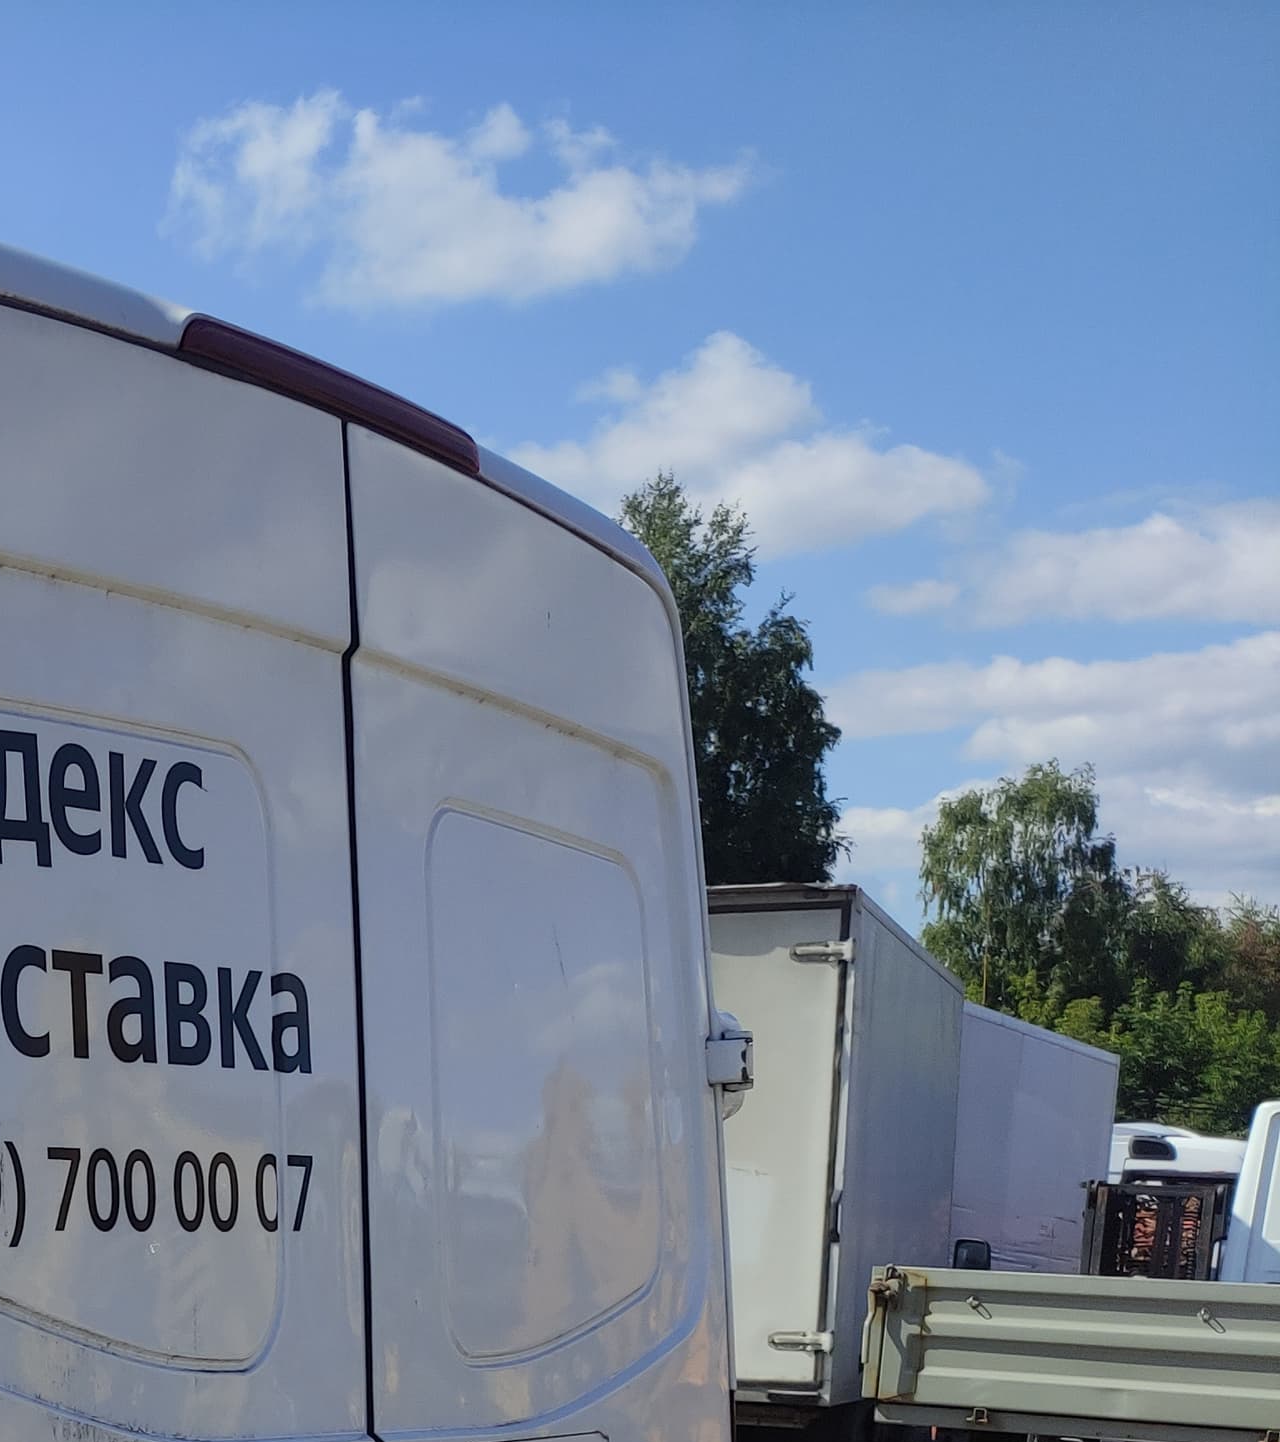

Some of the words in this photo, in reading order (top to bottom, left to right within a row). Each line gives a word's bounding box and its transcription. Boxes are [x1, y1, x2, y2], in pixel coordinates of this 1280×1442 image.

[46, 1147, 157, 1233] 700
[173, 1150, 240, 1233] 00
[255, 1152, 314, 1233] 07
